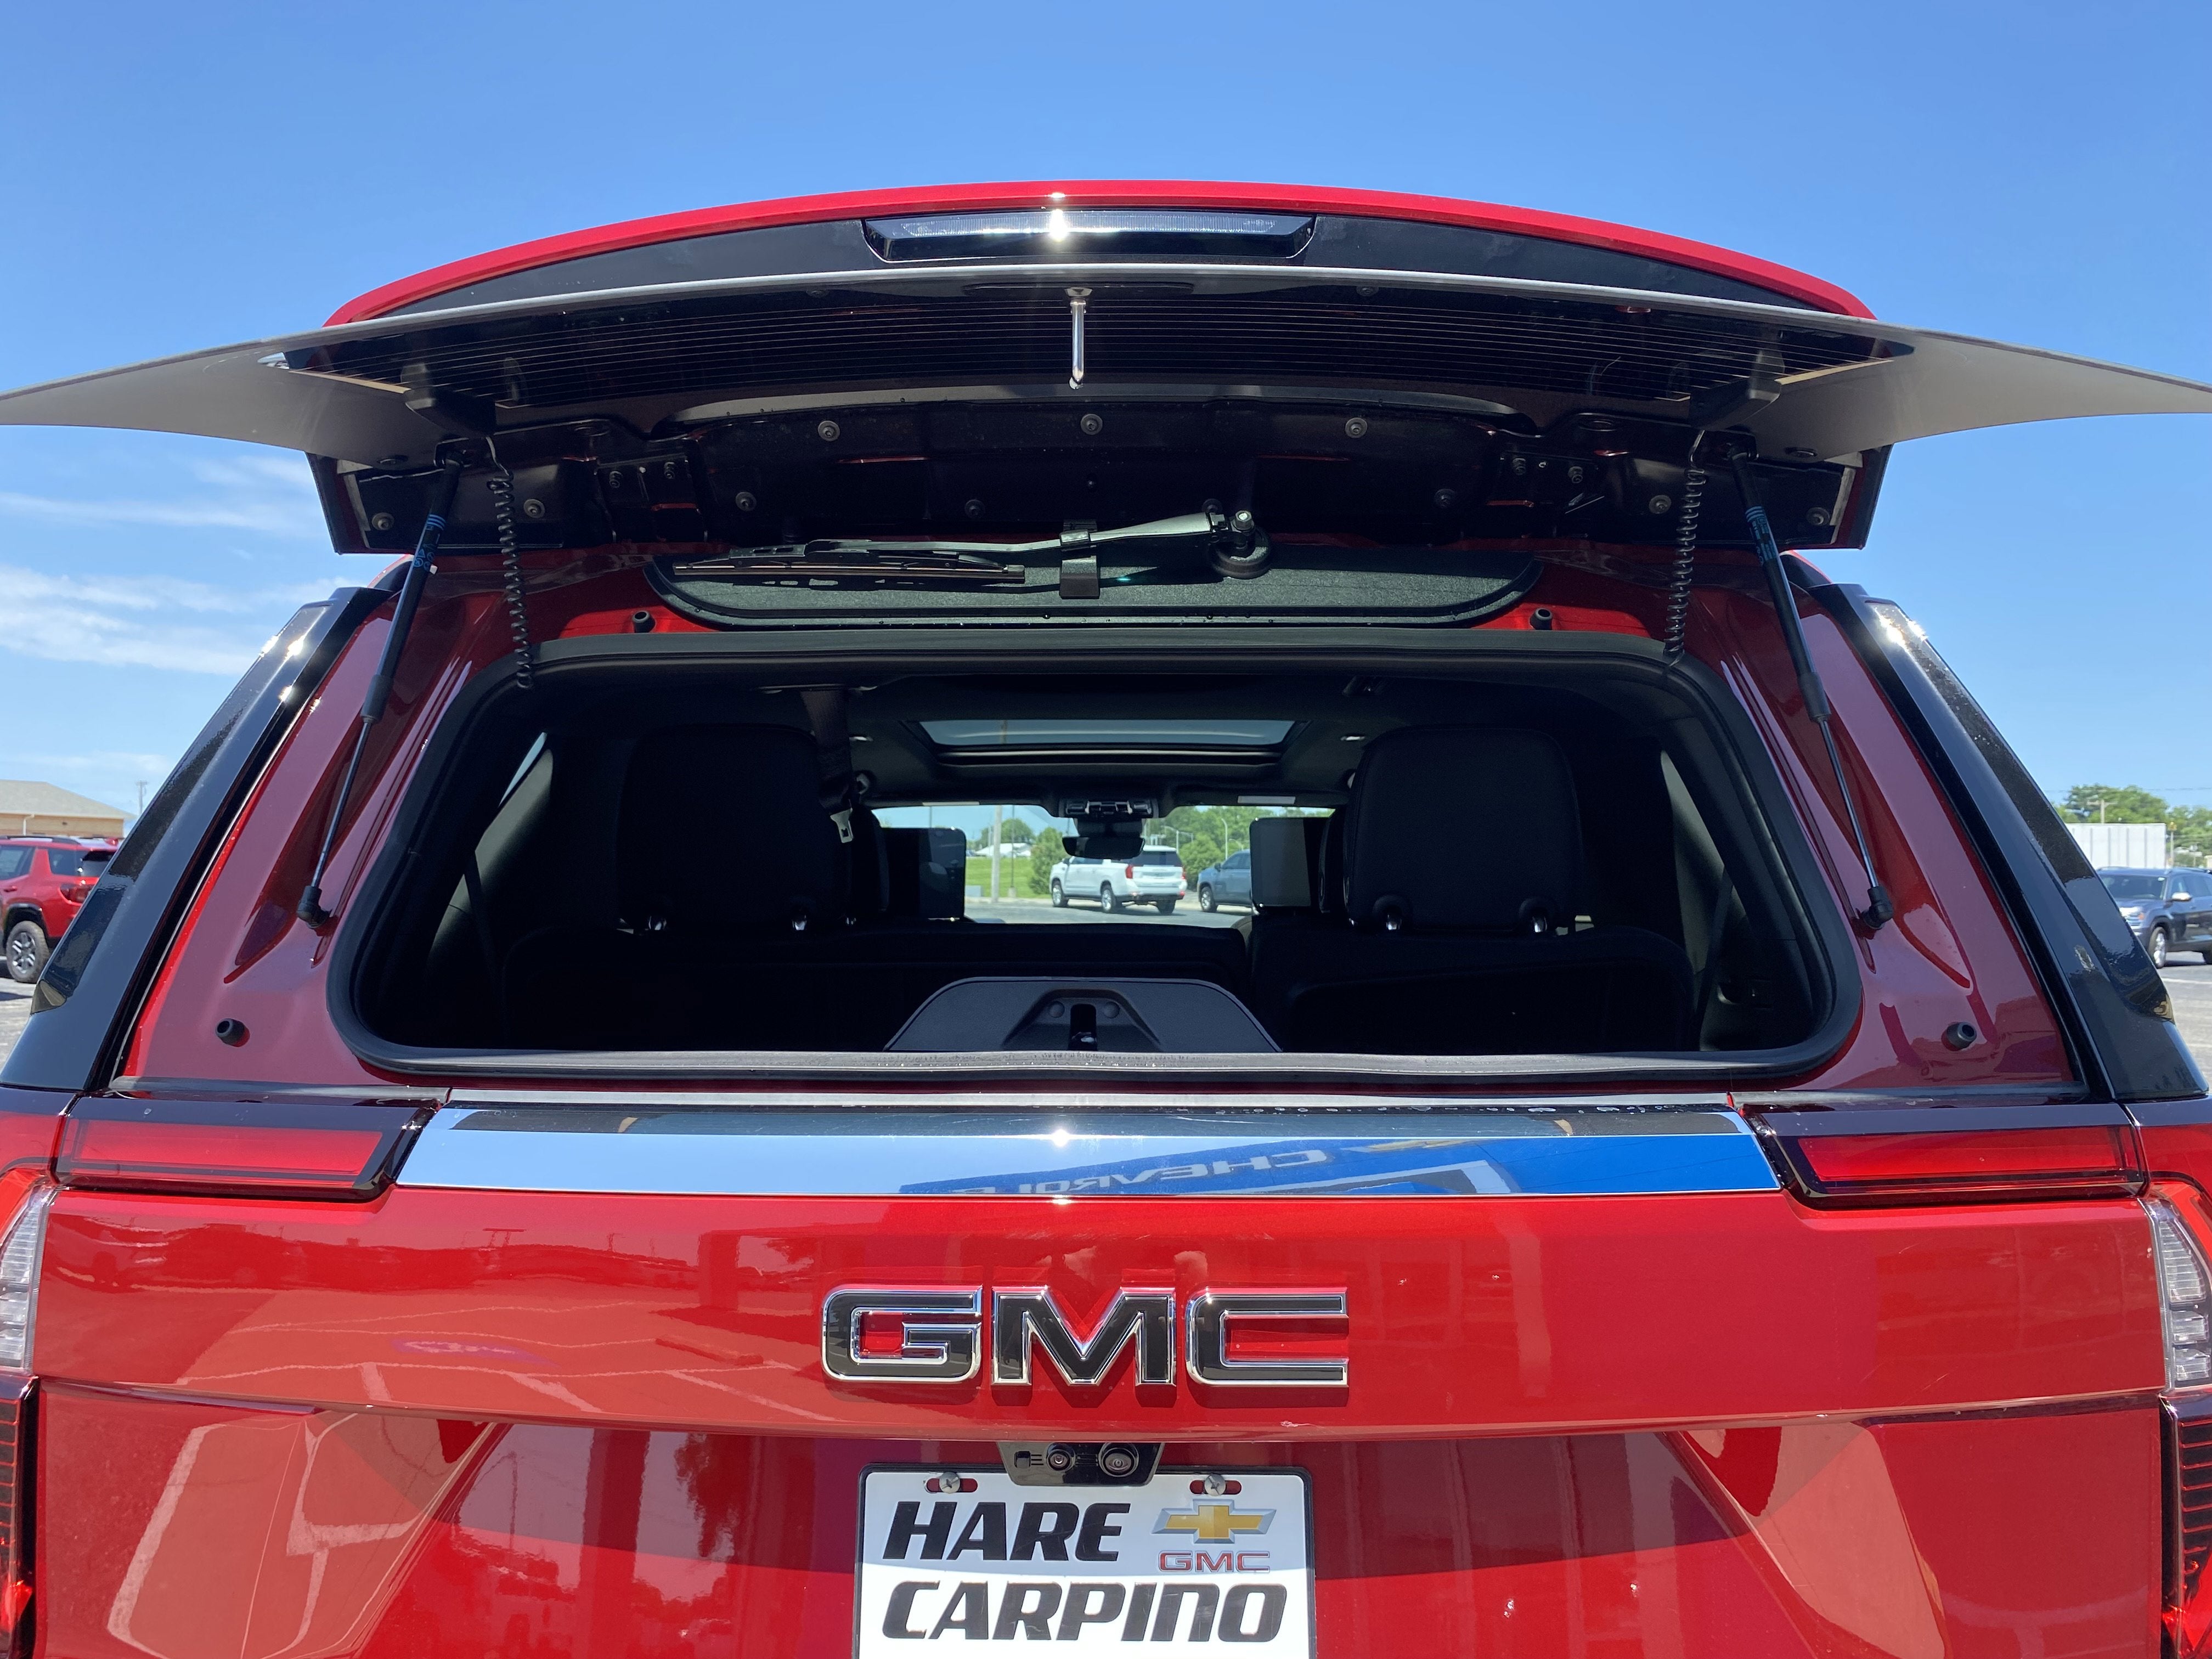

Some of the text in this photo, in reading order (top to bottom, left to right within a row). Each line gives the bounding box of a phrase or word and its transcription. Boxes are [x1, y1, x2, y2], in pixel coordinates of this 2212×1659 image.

[822, 1285, 1349, 1386] GMC
[882, 1501, 1131, 1561] HARE
[1159, 1550, 1270, 1573] GMC
[882, 1581, 1288, 1643] CARPINO
